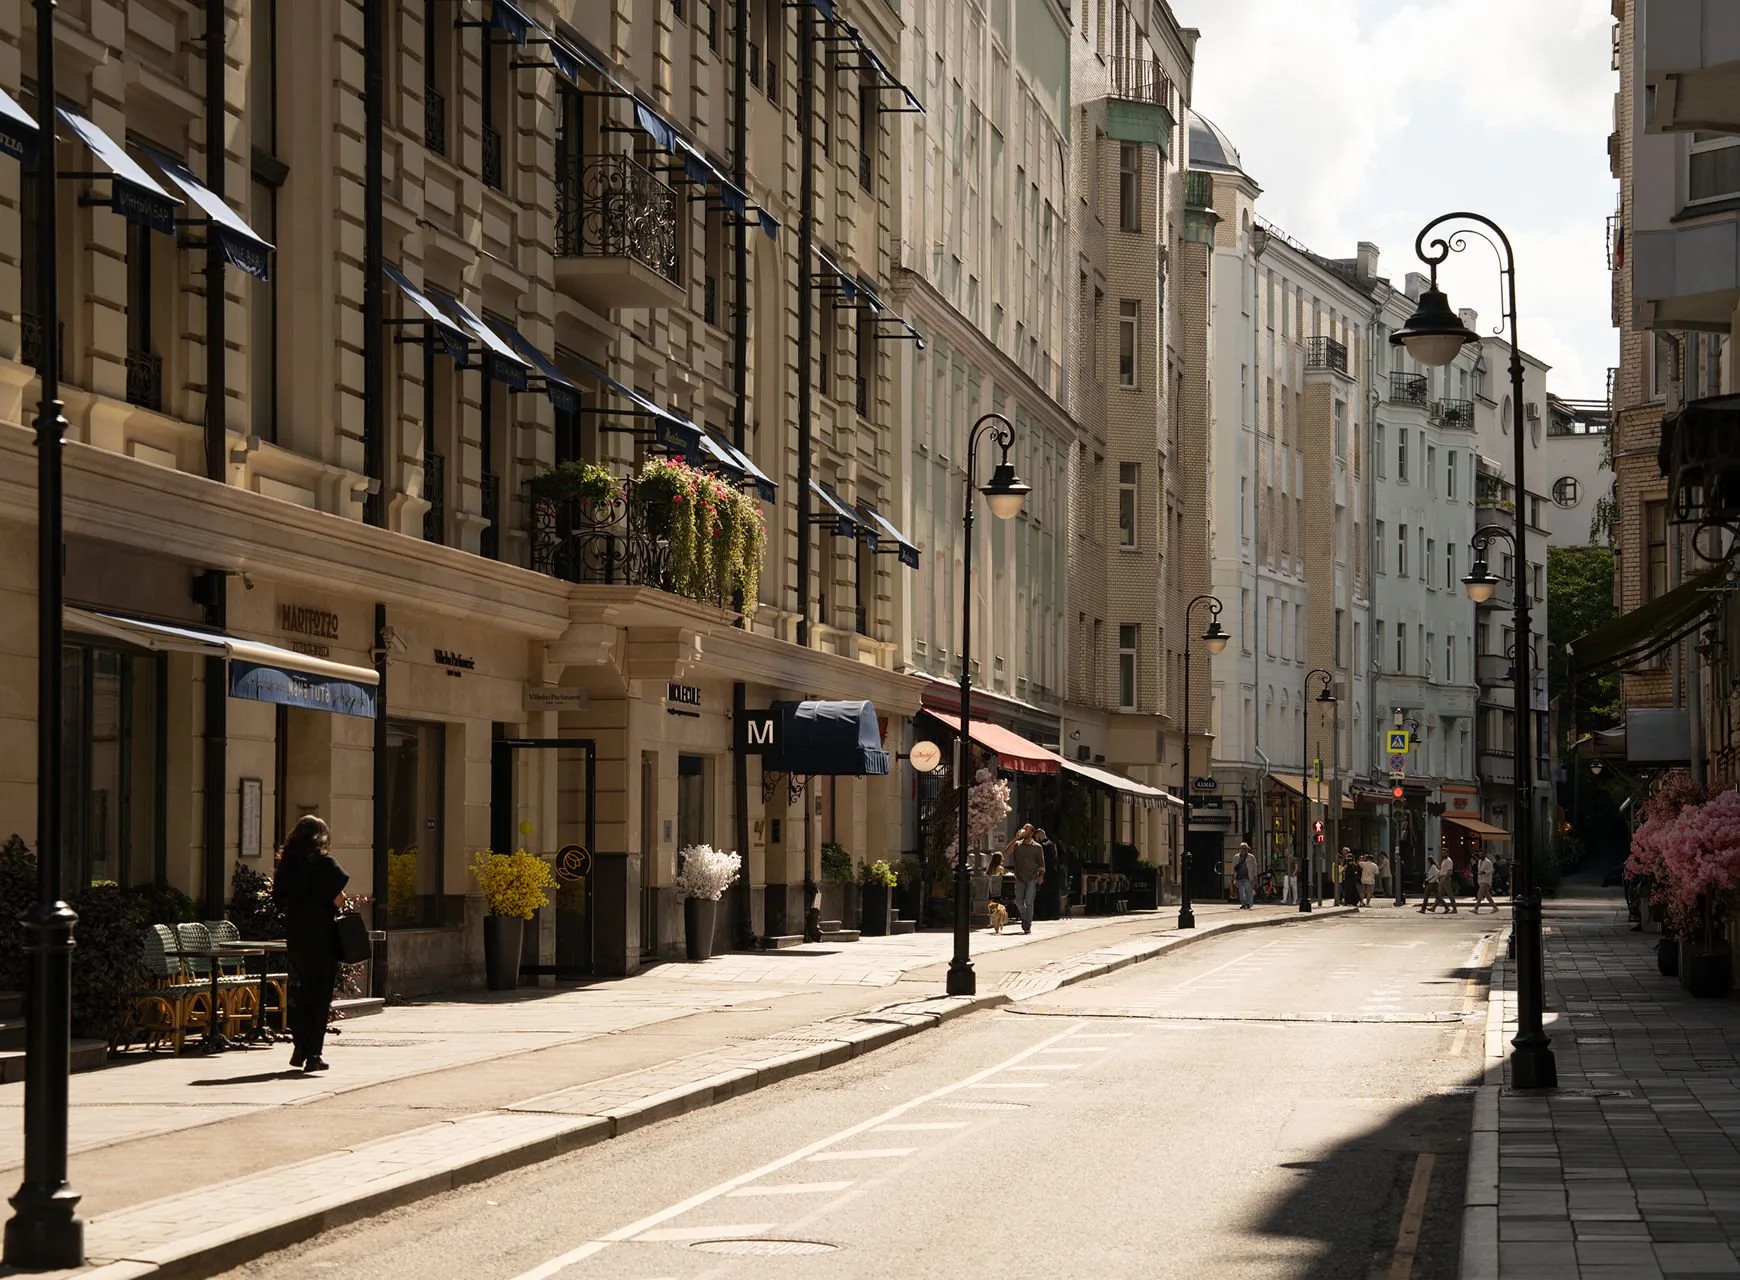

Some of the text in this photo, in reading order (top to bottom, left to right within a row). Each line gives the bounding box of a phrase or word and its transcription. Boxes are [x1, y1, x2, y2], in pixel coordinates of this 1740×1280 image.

[282, 603, 339, 640] MARITOZZO
[667, 682, 701, 706] MOLECULE
[748, 720, 774, 744] M
